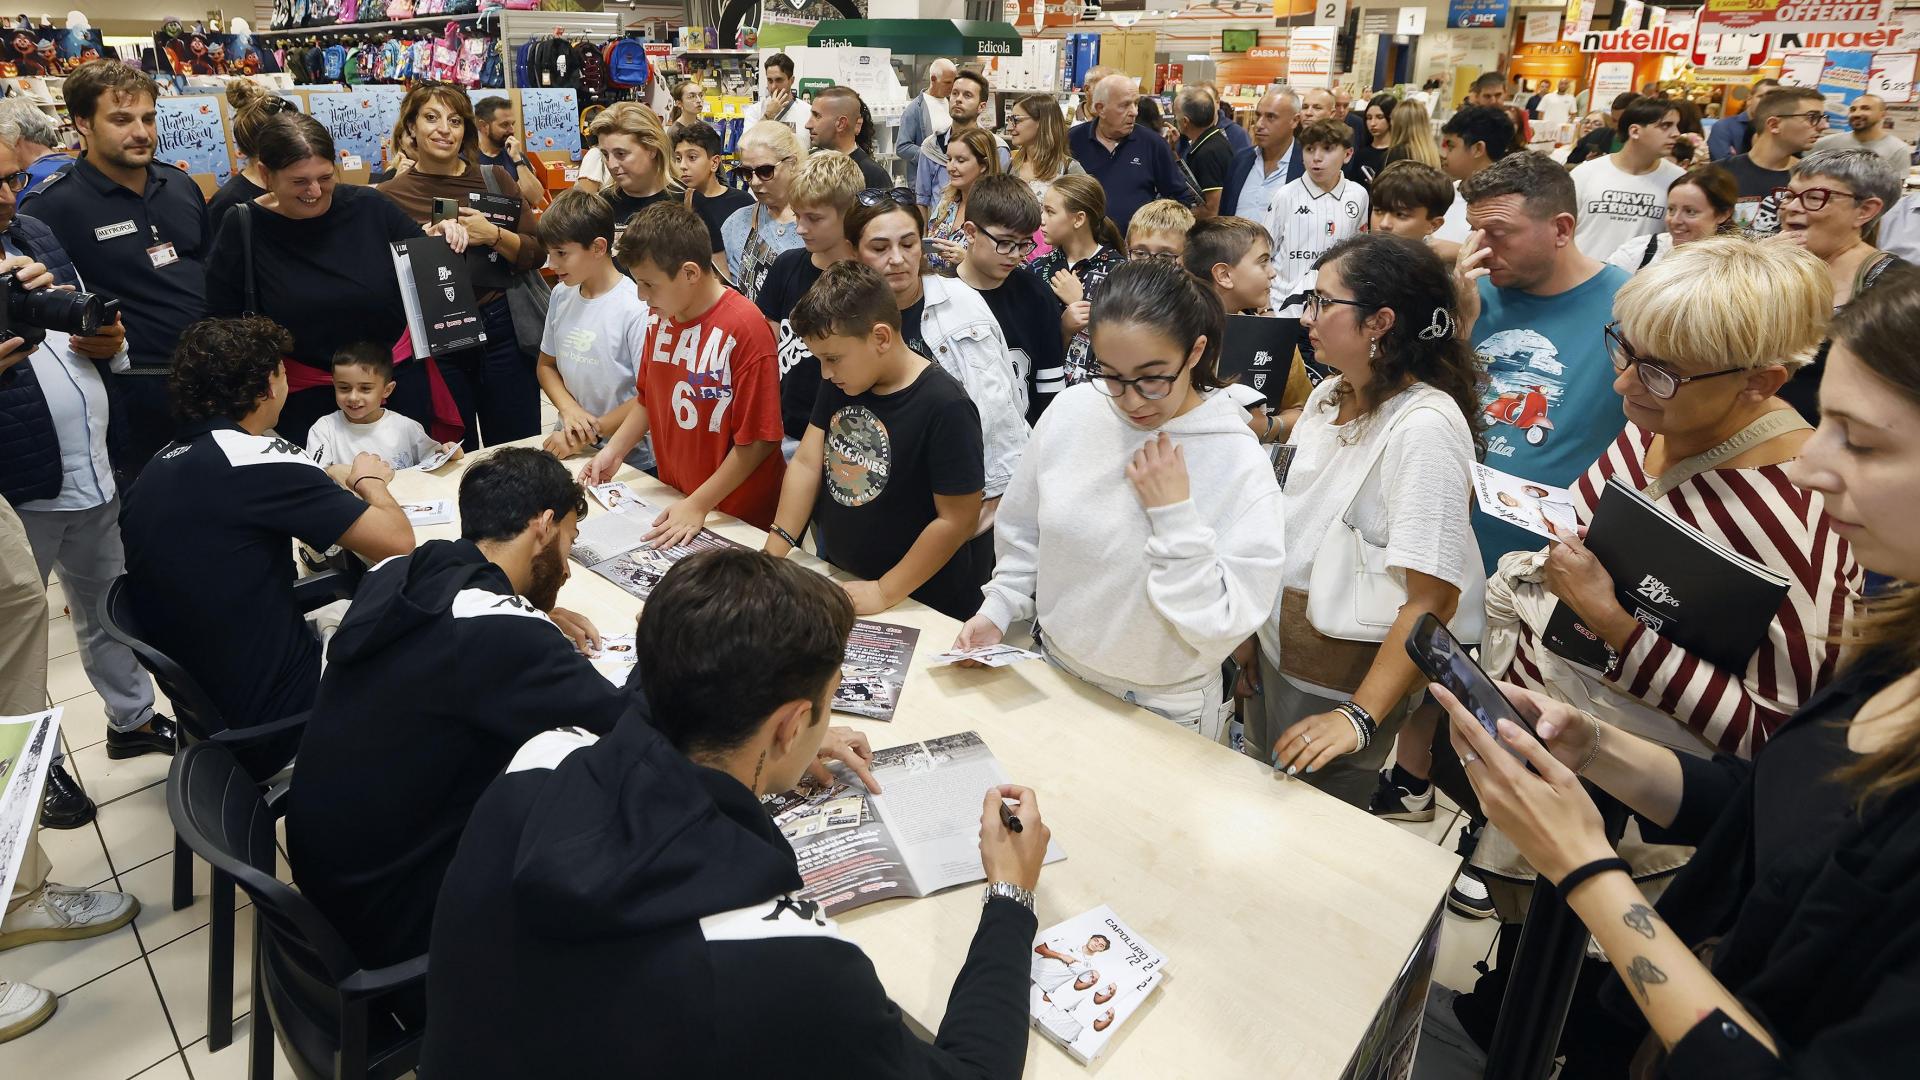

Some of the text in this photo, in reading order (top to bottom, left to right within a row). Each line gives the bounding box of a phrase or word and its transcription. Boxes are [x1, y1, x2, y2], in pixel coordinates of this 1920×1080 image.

[1325, 3, 1336, 18] 2
[1776, 4, 1879, 21] OFFERTE
[1408, 14, 1414, 26] 1
[820, 39, 853, 48] Edicola
[978, 40, 1010, 54] Edicola
[1584, 27, 1689, 51] nutella
[1529, 46, 1575, 55] THUN
[329, 107, 357, 124] Happy
[537, 101, 560, 114] Happy
[159, 113, 195, 132] Happy
[533, 112, 571, 132] Halloween
[157, 126, 214, 154] Halloween
[1602, 190, 1655, 206] CURVA
[1588, 201, 1664, 219] FERROVIA
[98, 223, 134, 237] METROPOL
[647, 312, 737, 386] TEAM
[875, 426, 888, 458] MAKERS
[1488, 435, 1516, 458] ilia
[829, 433, 888, 477] ACK&JONES
[1105, 918, 1149, 961] CAPOLUPO
[1125, 952, 1142, 967] 72
